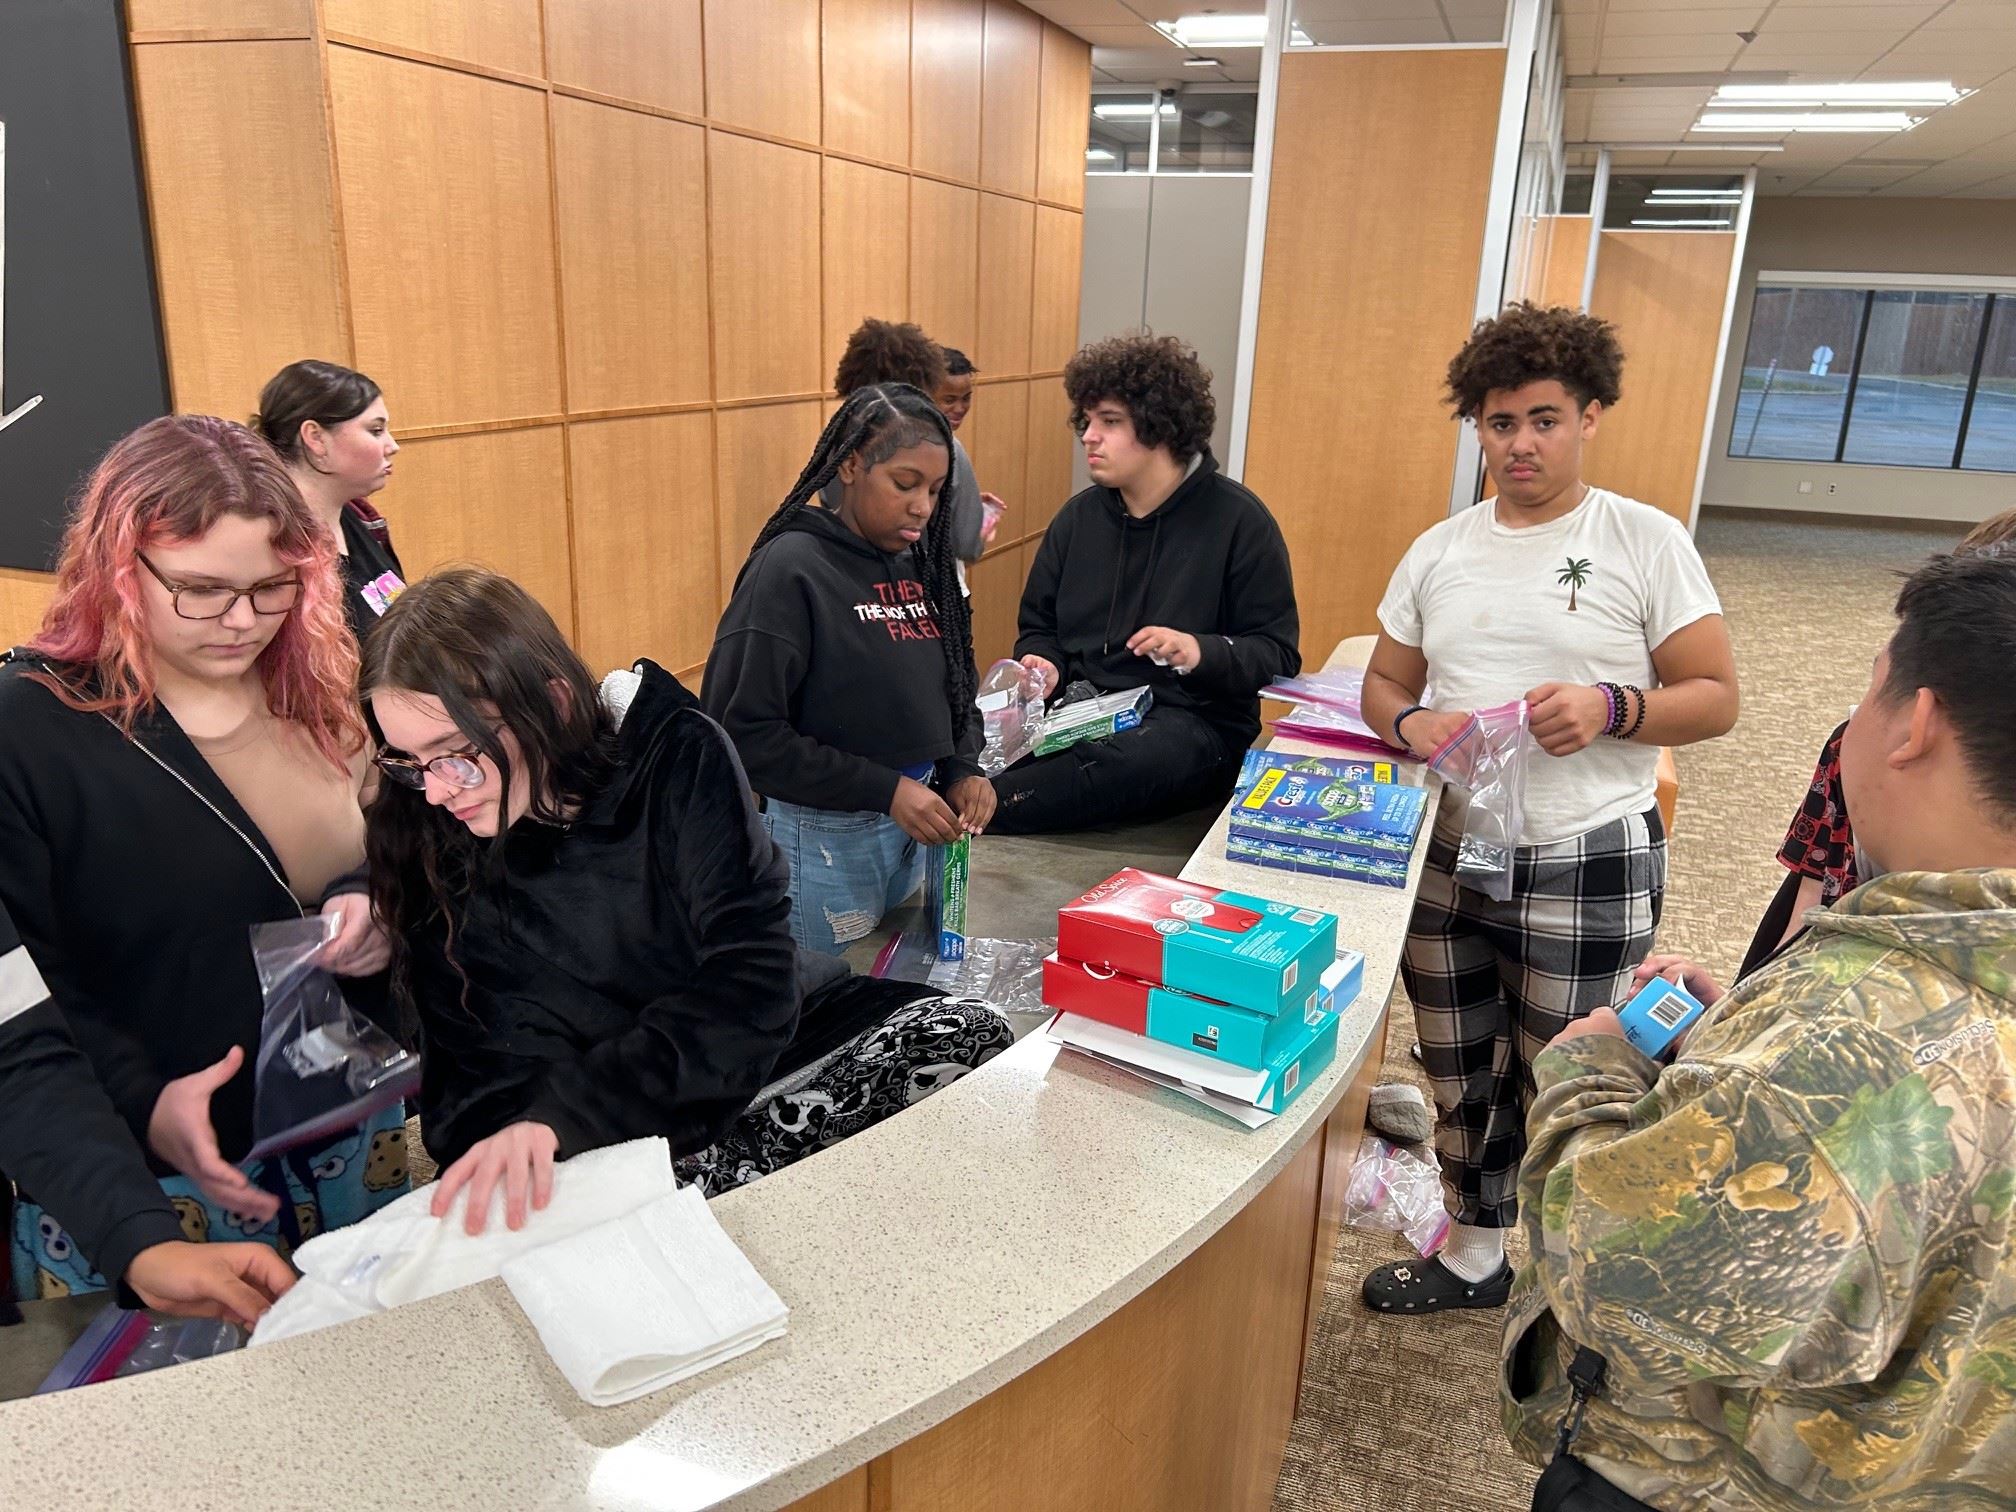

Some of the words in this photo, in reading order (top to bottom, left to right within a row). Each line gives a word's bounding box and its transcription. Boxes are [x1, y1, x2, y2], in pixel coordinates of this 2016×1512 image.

[873, 580, 918, 603] THE
[853, 604, 885, 621] THE
[1277, 779, 1302, 806] Crest
[1081, 890, 1106, 902] Old
[1099, 878, 1128, 890] Spice
